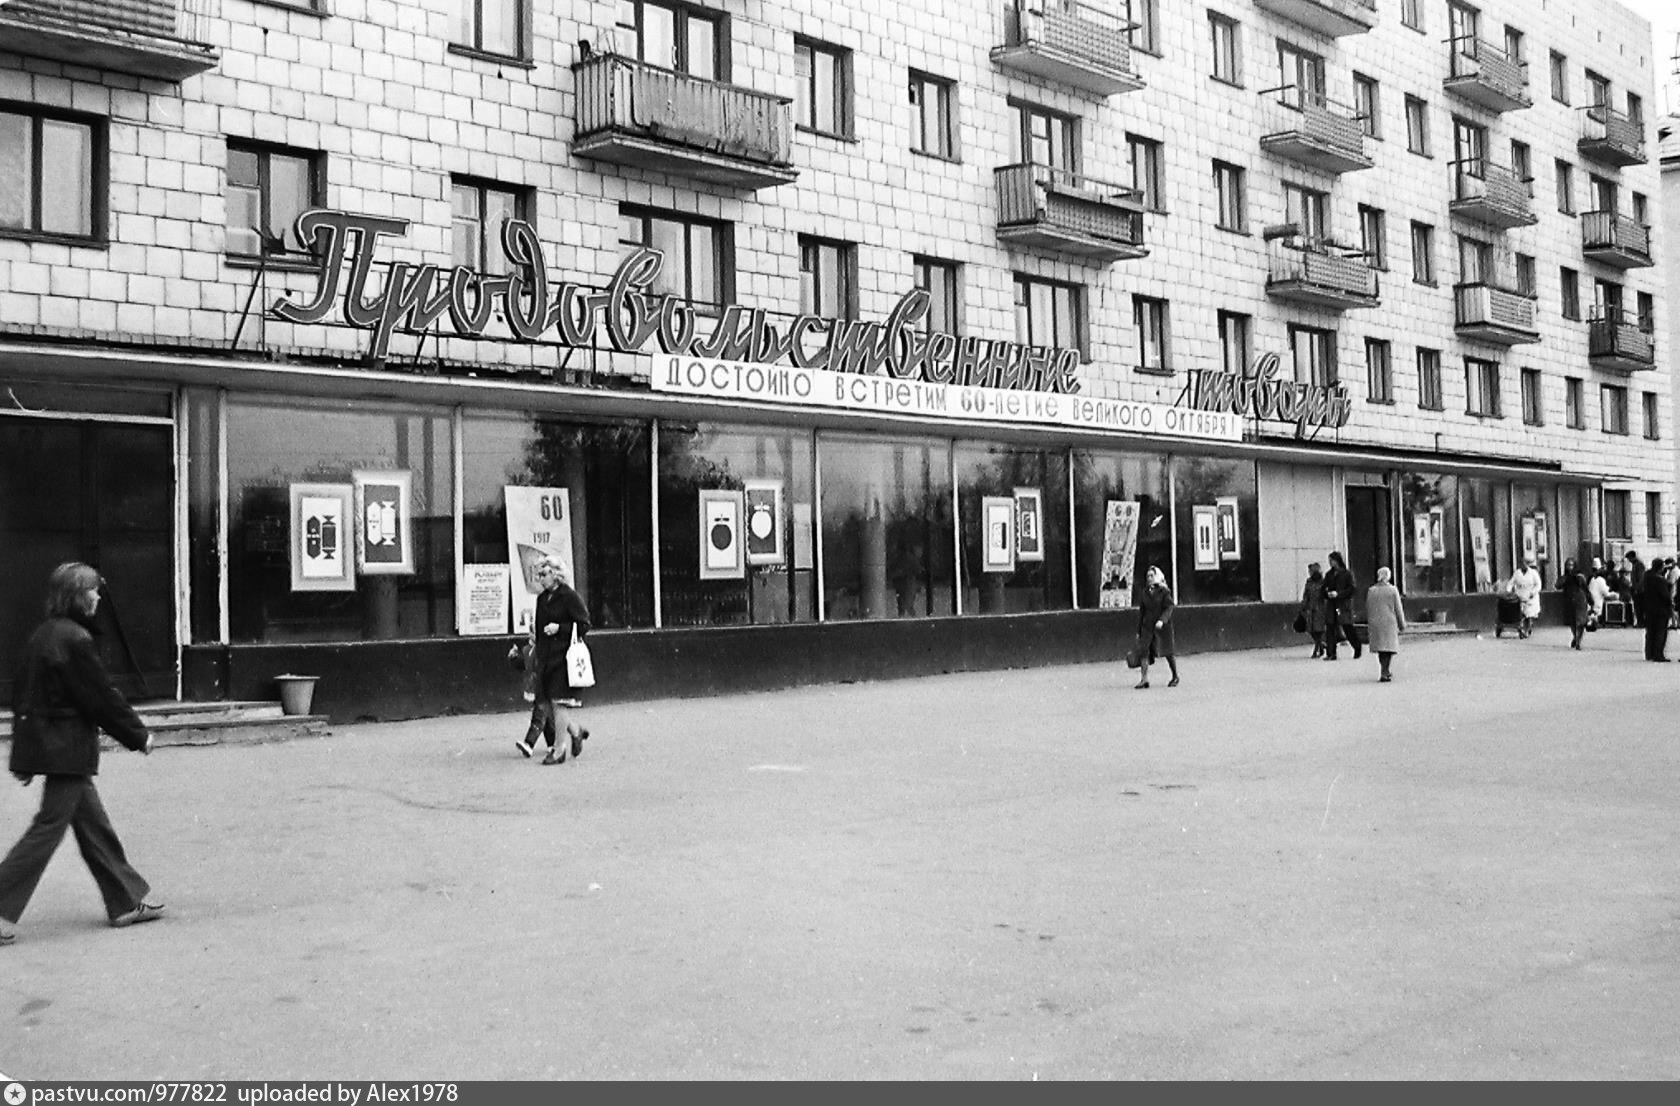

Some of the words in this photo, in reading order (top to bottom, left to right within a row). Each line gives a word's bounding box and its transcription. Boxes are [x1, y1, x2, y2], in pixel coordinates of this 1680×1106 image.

[271, 209, 1081, 395] Продовольственные
[1193, 352, 1351, 439] товары
[540, 494, 563, 521] 60
[533, 532, 550, 544] 1917
